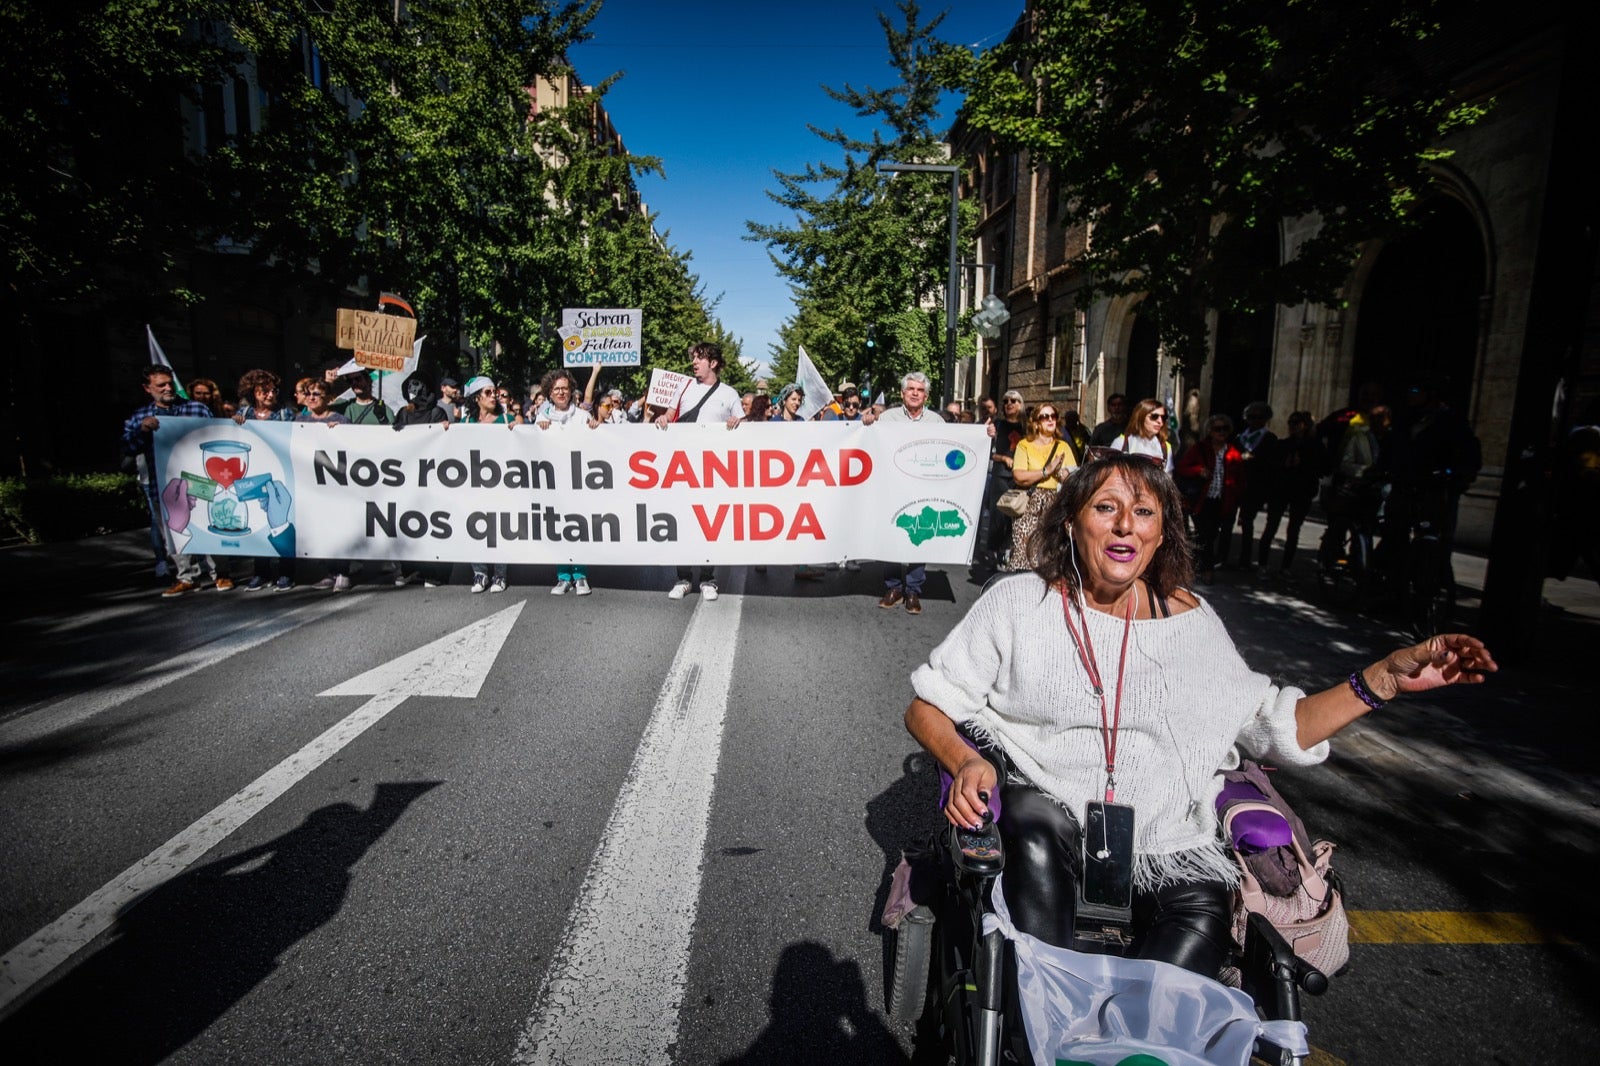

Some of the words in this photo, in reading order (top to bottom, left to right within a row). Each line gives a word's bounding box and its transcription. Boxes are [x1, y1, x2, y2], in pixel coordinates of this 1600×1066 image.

[356, 311, 378, 329] SOY
[575, 312, 632, 328] Sobran
[582, 337, 632, 353] Faltan
[566, 351, 638, 363] CONTRATOS
[314, 450, 405, 487] Nos
[418, 449, 555, 490] roban
[570, 450, 613, 490] la
[628, 448, 873, 490] SANIDAD
[365, 501, 453, 539] Nos
[466, 503, 620, 548] quitan
[636, 503, 678, 542] la
[691, 502, 826, 542] VIDA
